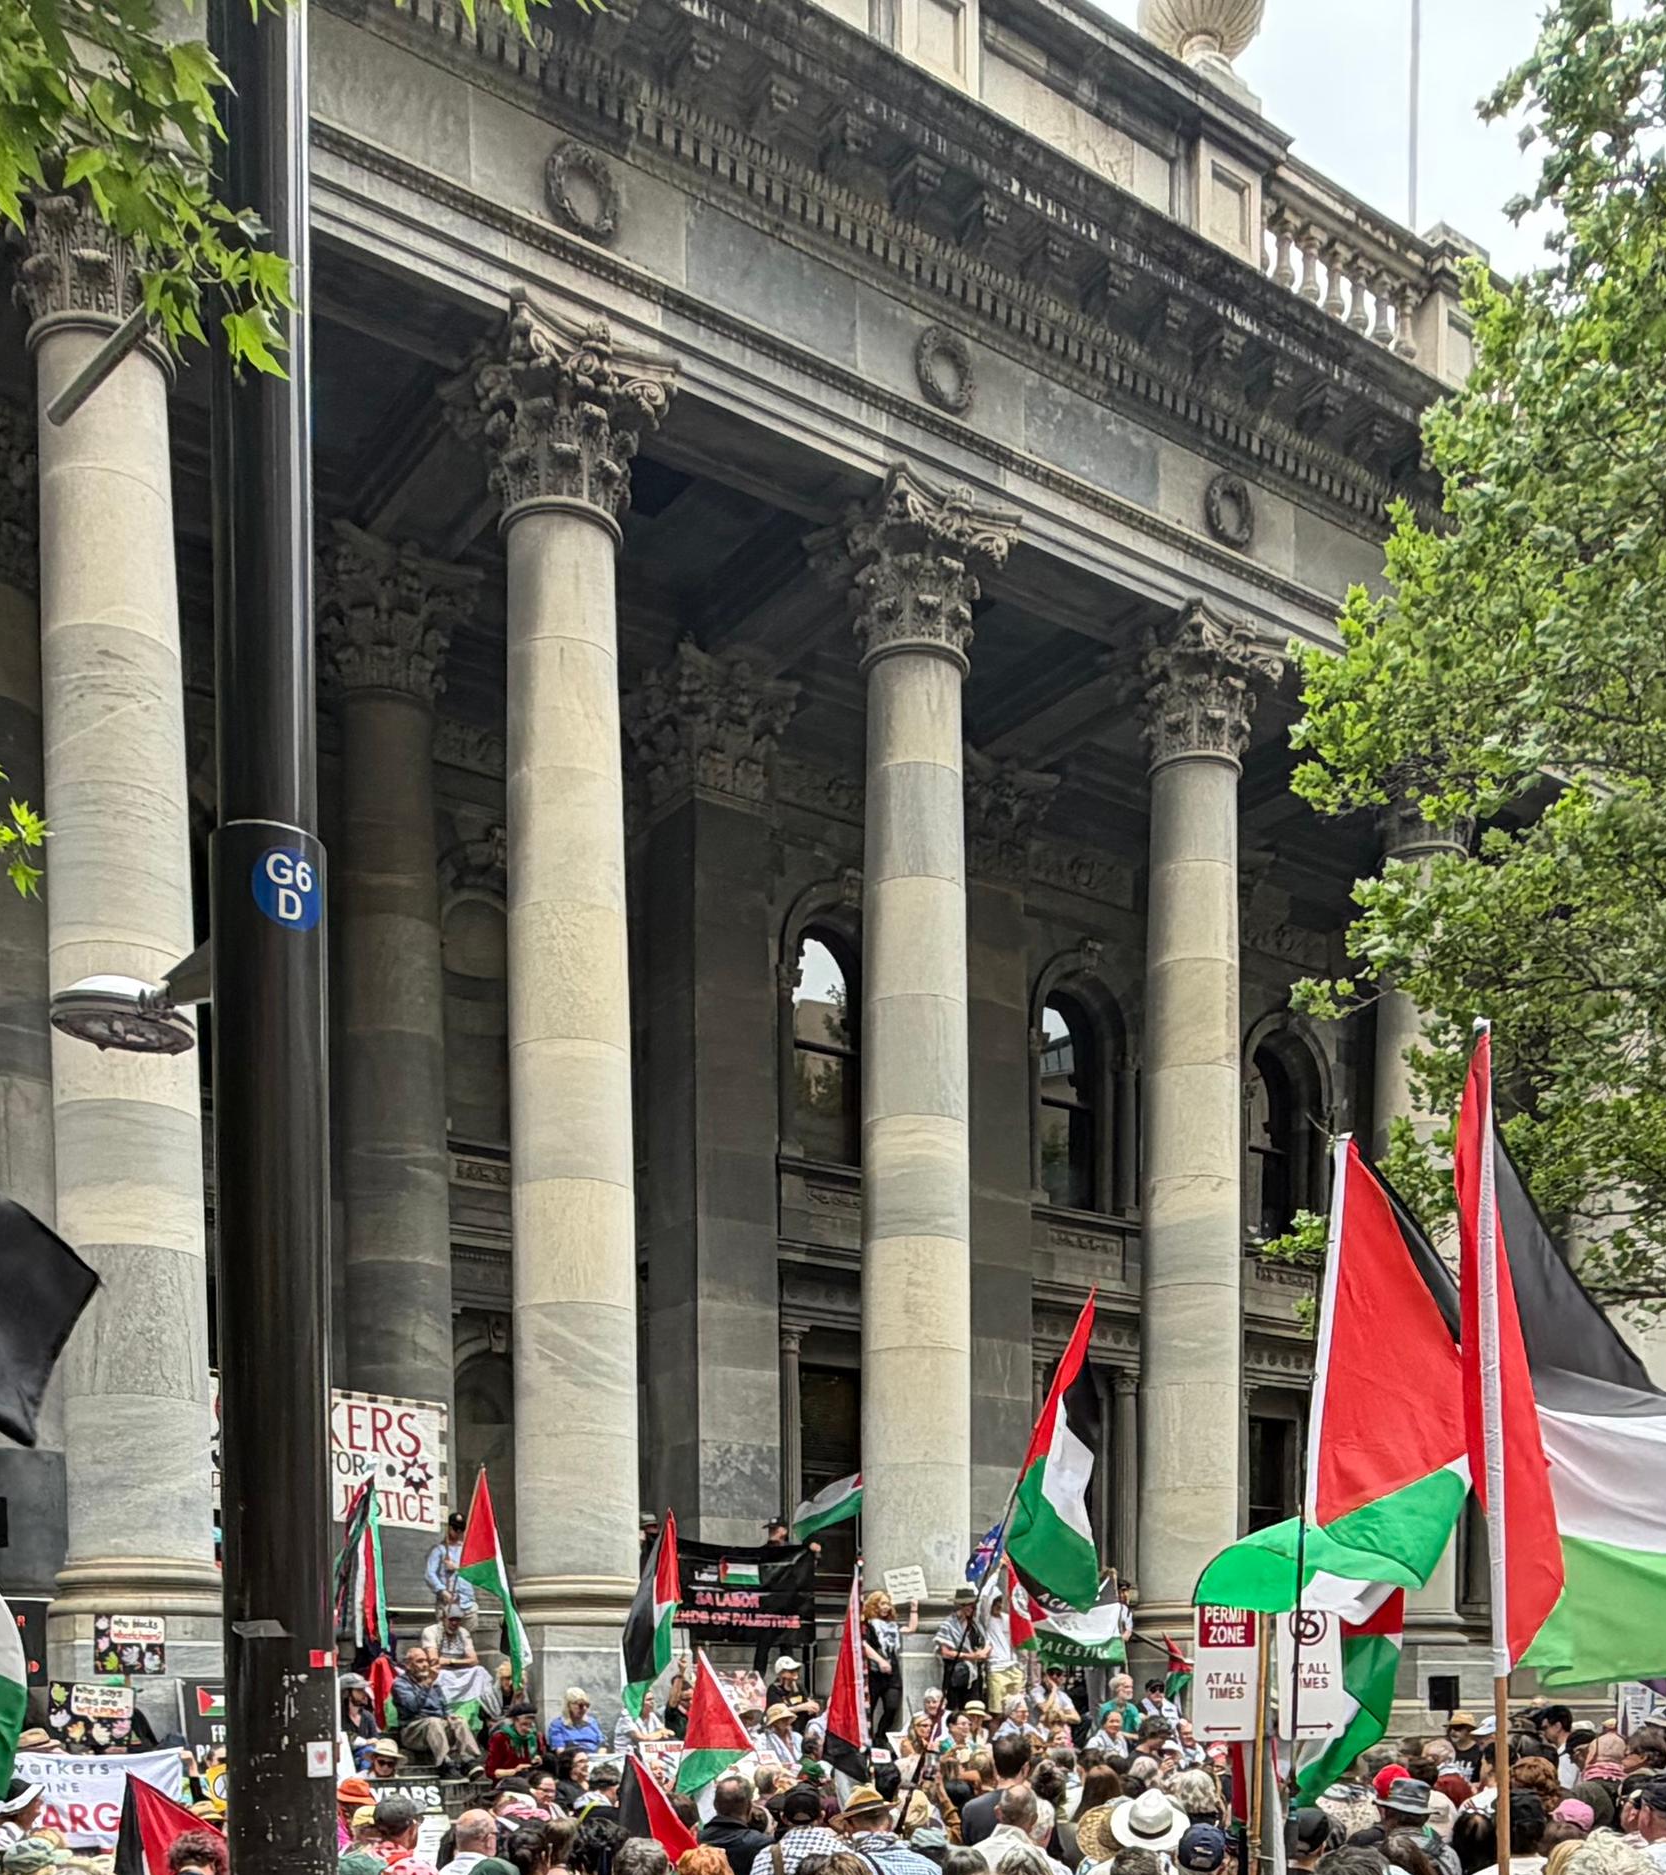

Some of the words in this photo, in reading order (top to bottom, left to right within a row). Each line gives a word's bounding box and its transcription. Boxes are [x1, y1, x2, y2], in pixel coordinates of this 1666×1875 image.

[266, 853, 312, 892] G6
[278, 888, 302, 920] D
[695, 1591, 714, 1606] SA
[715, 1592, 761, 1609] LABOR
[1204, 1606, 1248, 1624] PERMIT
[1208, 1626, 1246, 1644] ZONE
[1307, 1663, 1331, 1675] ALL
[1205, 1673, 1222, 1685] AT
[1224, 1673, 1247, 1685] ALL
[1299, 1677, 1329, 1689] IMES
[1208, 1687, 1245, 1699] TIMES
